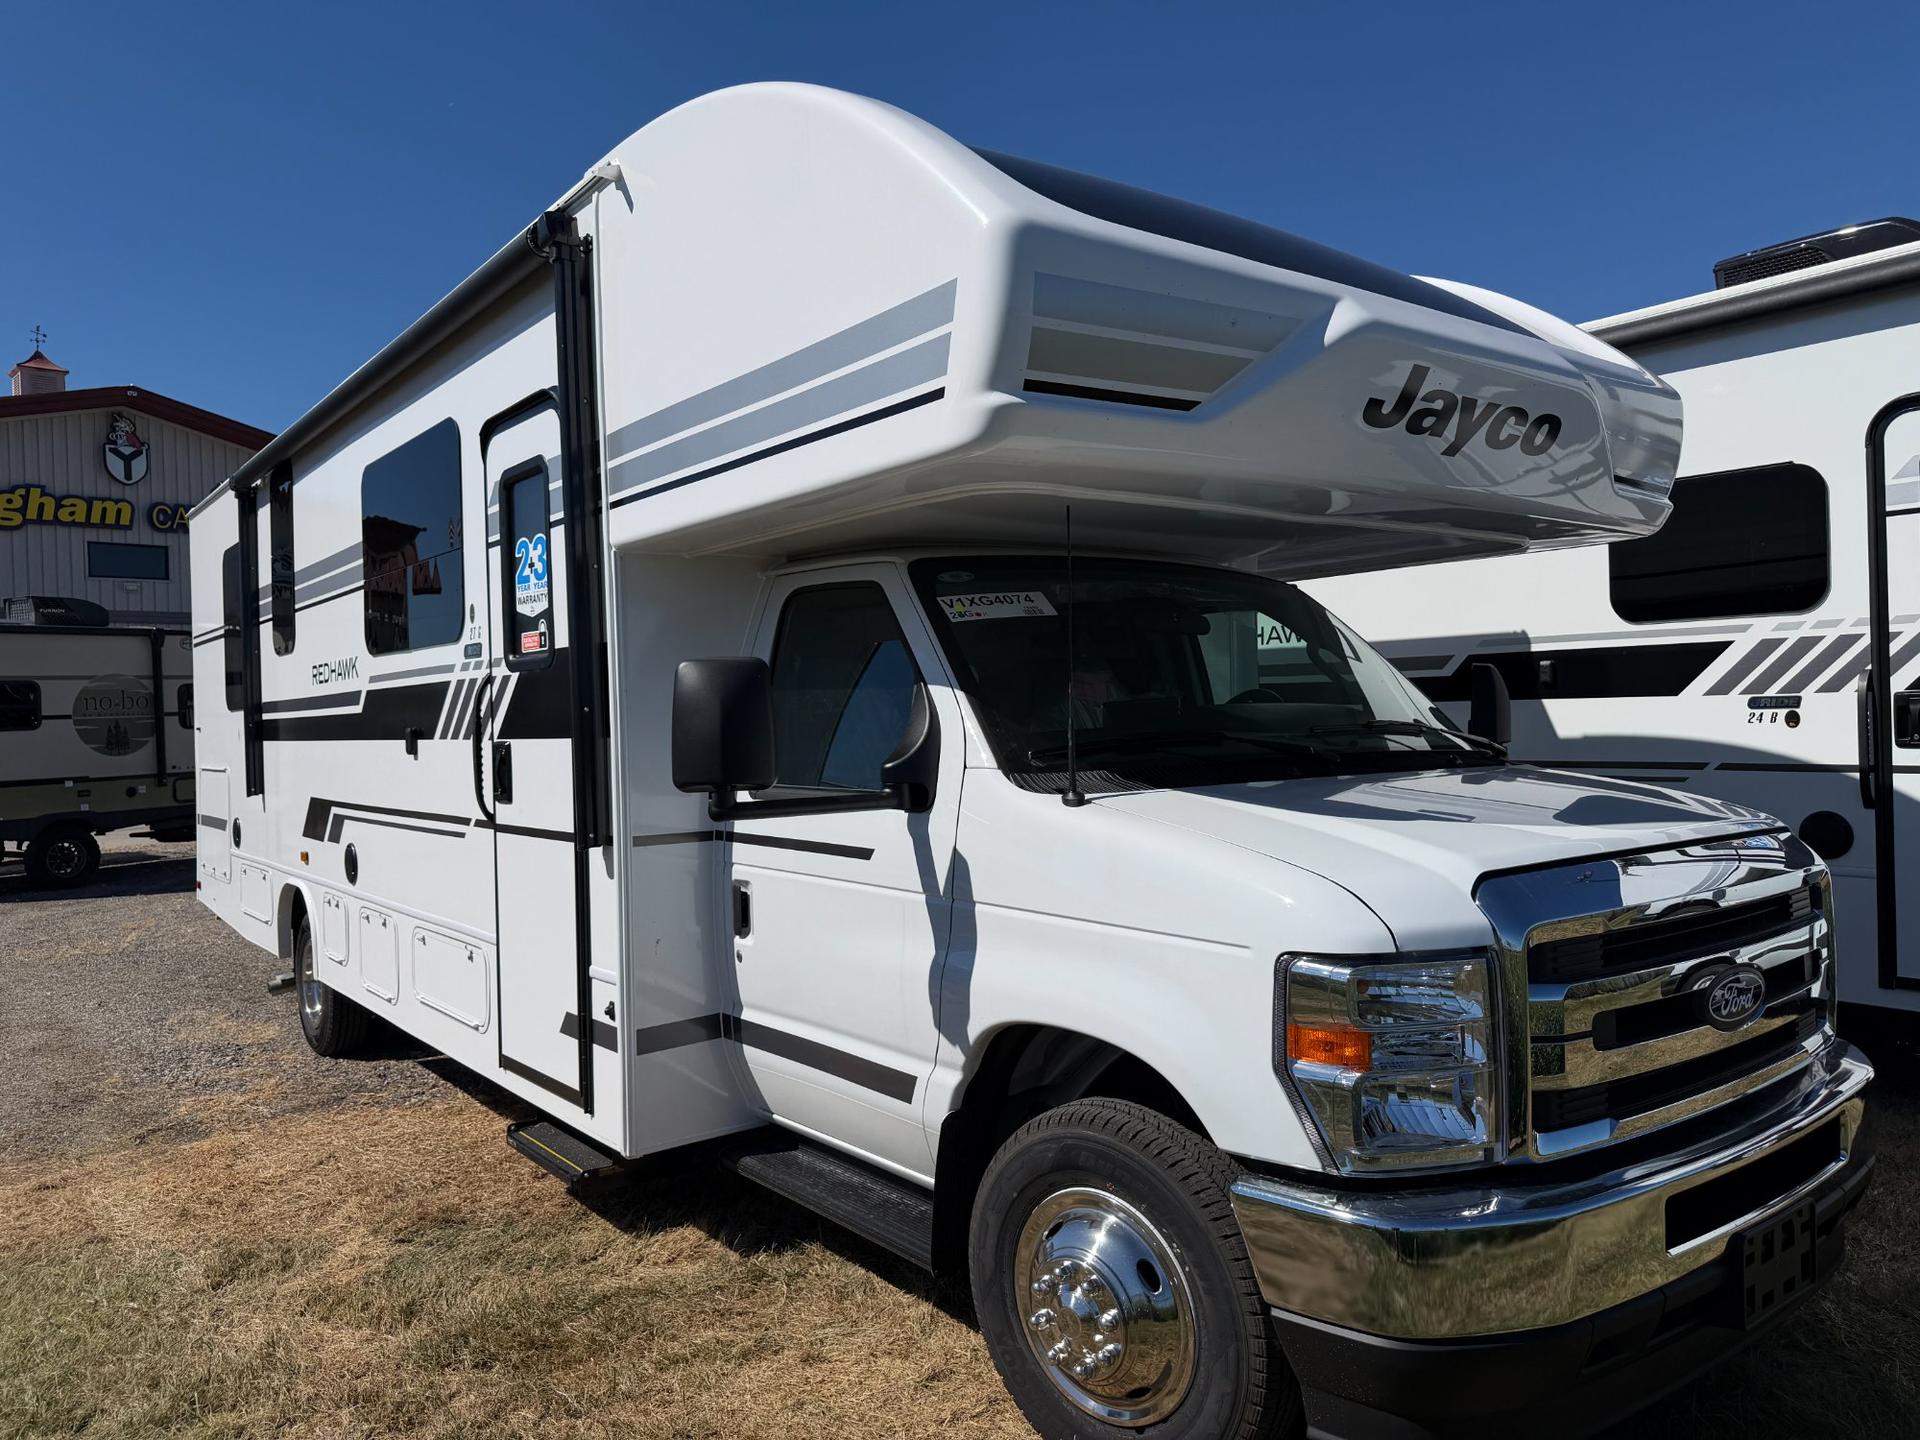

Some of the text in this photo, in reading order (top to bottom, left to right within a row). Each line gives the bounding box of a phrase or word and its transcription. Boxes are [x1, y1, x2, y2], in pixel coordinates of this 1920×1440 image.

[1362, 364, 1562, 457] Jayco
[0, 487, 132, 527] gham
[518, 592, 548, 605] WARRANTY
[941, 594, 1035, 609] V1XG4074
[312, 656, 359, 685] REDHAWK
[1747, 712, 1764, 723] 24
[1721, 981, 1755, 1015] Ford
